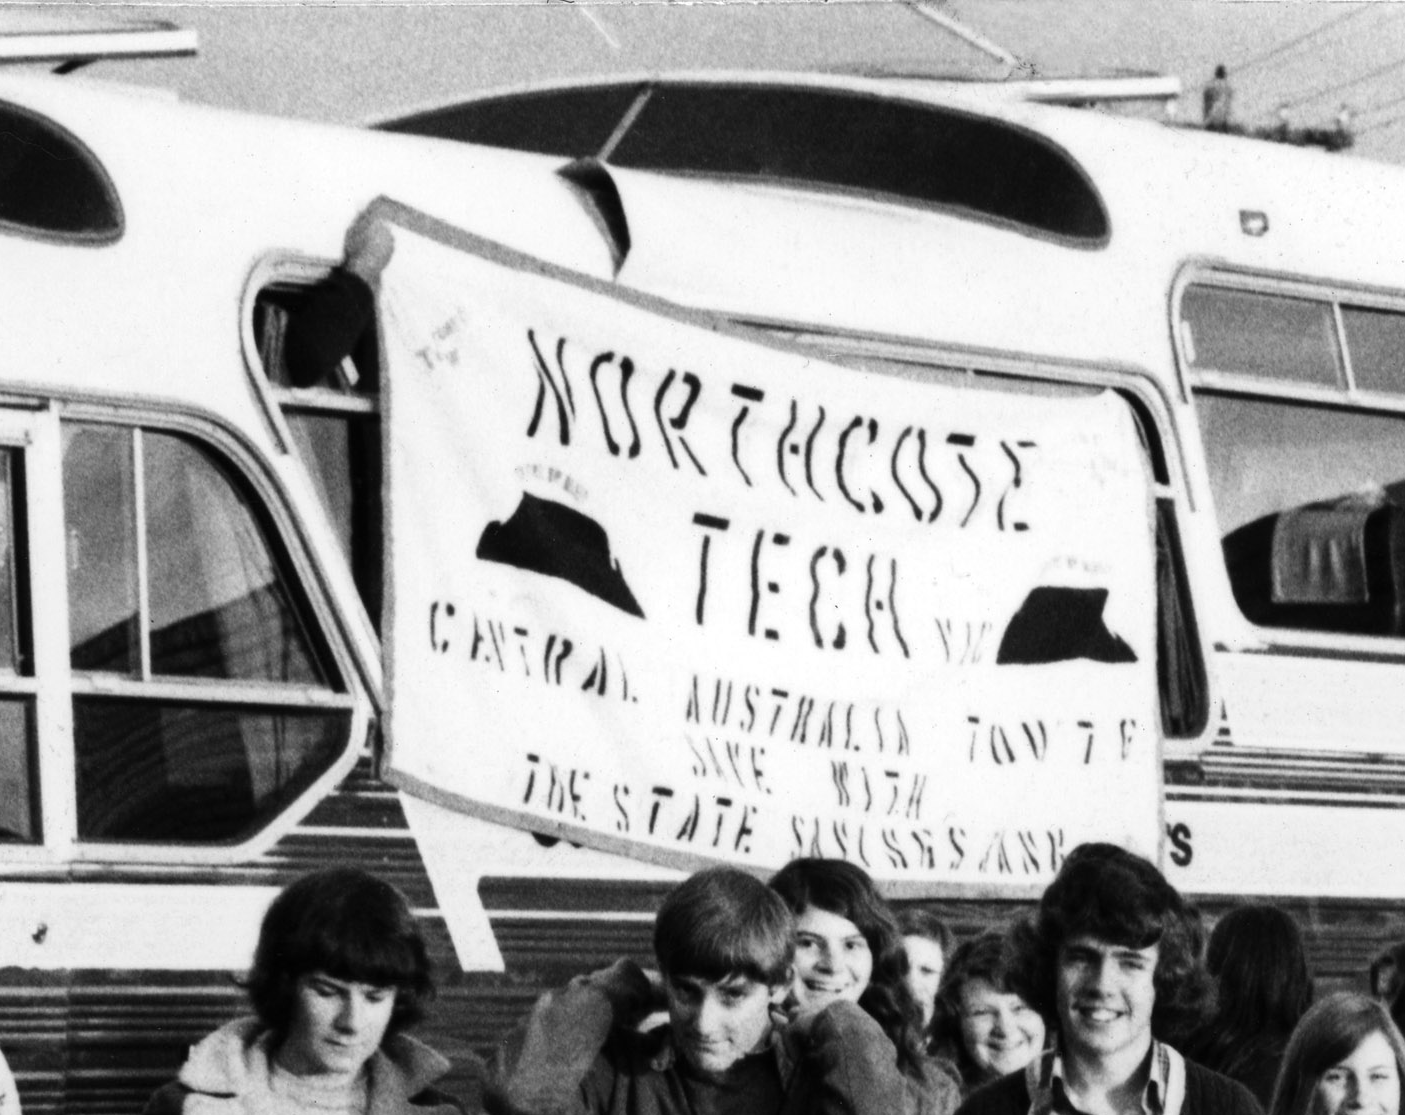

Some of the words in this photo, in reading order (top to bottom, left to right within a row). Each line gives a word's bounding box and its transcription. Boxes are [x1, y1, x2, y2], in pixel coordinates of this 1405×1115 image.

[526, 328, 1037, 532] NORTHCOTE
[692, 512, 910, 659] TECH
[686, 673, 910, 756] AUSTRALIA
[522, 752, 591, 822] THE
[612, 783, 753, 854] STATE
